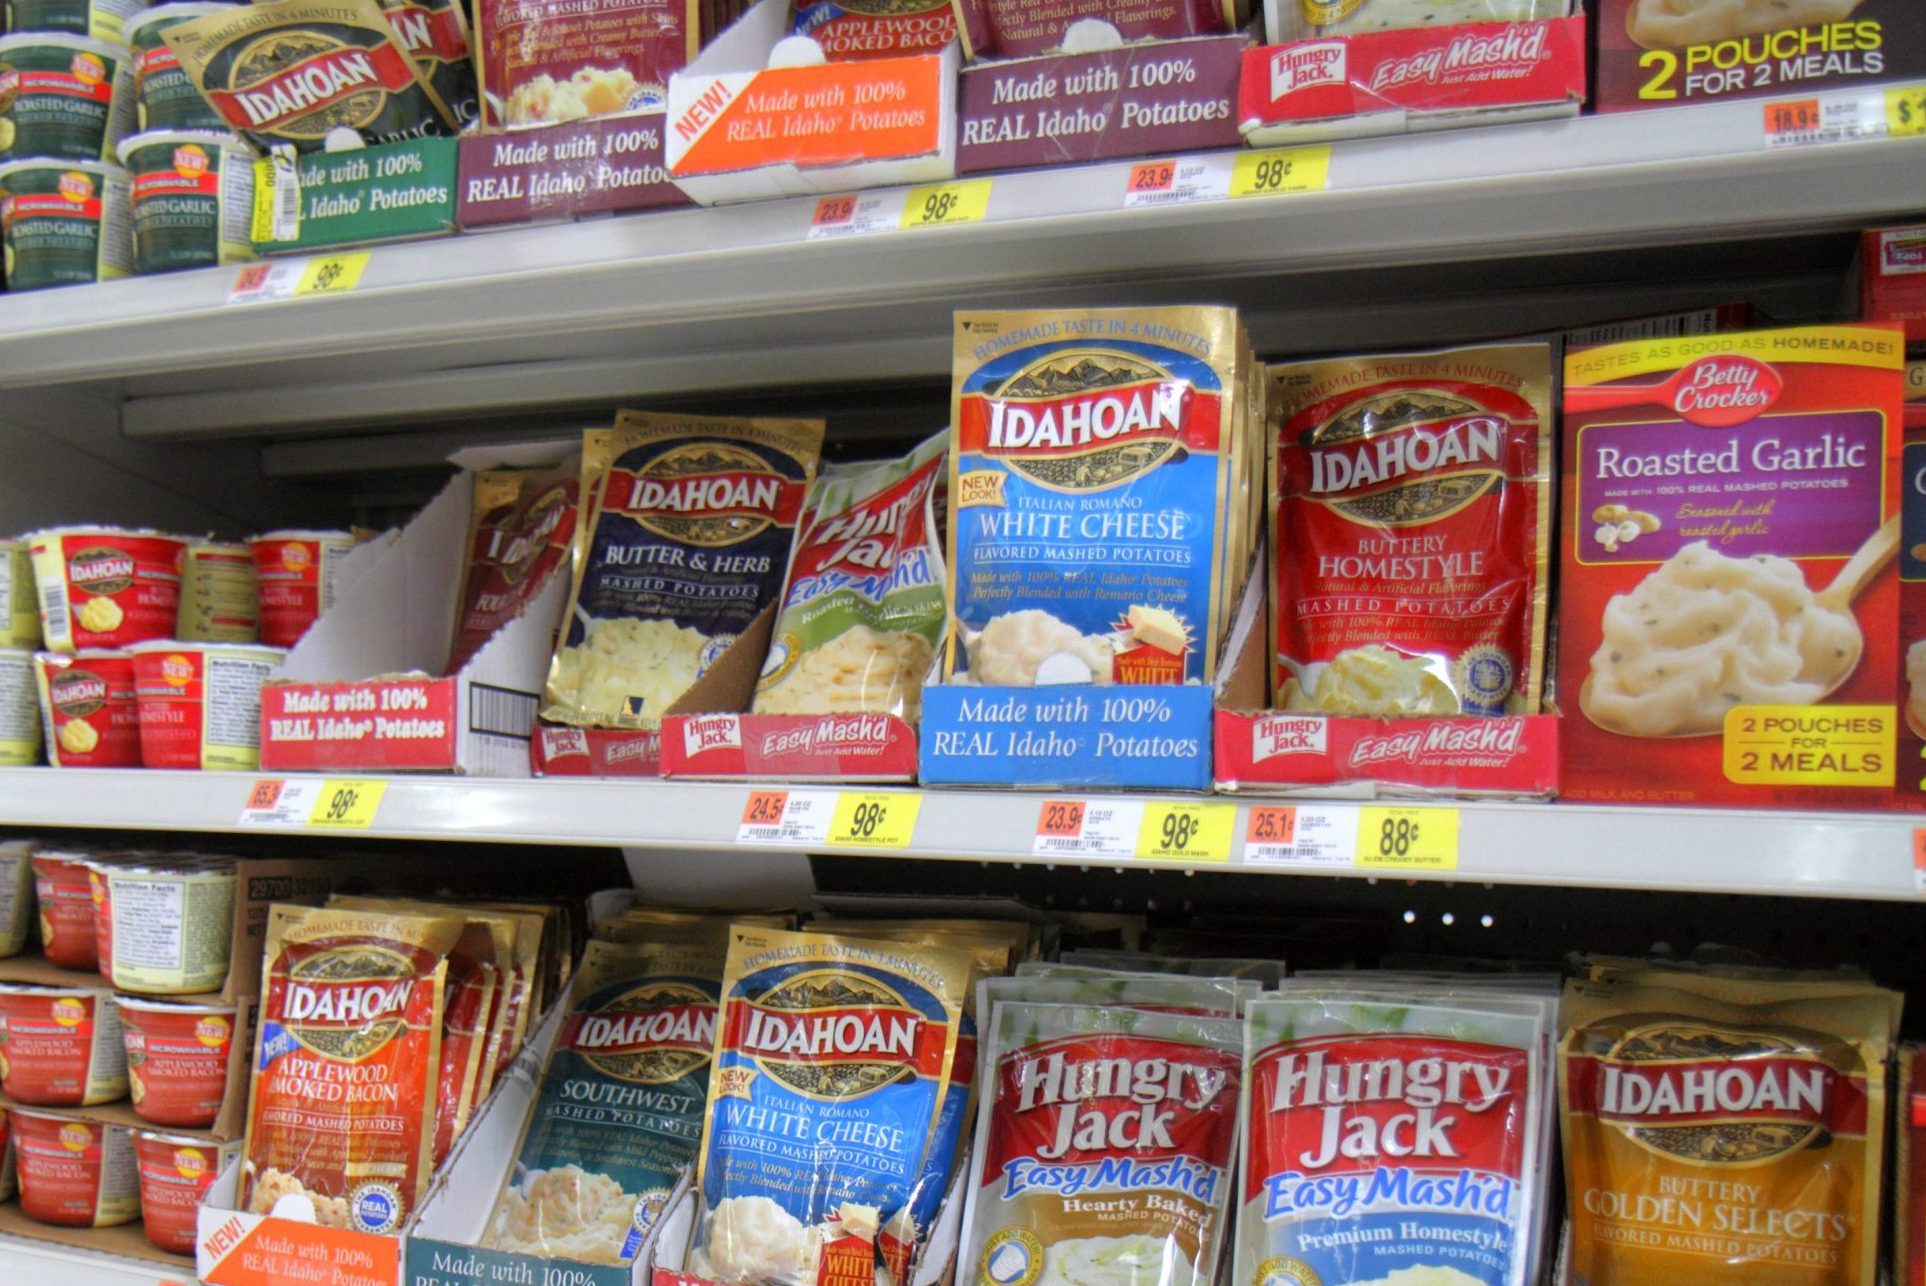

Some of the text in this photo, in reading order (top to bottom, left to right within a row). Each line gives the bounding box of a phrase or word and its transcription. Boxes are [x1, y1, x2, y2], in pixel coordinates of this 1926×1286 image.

[1278, 47, 1341, 75] Hungry
[1373, 24, 1546, 89] Easy Mash'd
[1639, 21, 1882, 100] 2 POUCHES
[235, 53, 378, 126] IDAHOAN
[992, 59, 1195, 104] Made with 100%
[1685, 52, 1884, 97] FOR 2 MEALS
[674, 80, 732, 141] NEW!
[745, 82, 905, 114] Made with 100%
[727, 120, 776, 142] REAL
[849, 108, 925, 132] Potatoes
[962, 115, 1030, 146] REAL
[1120, 99, 1230, 128] Potatoes
[494, 129, 658, 167] Made with 100%
[331, 153, 422, 183] with 100%
[370, 186, 447, 211] Potatoes
[467, 176, 523, 203] REAL
[1062, 319, 1213, 354] TASTE IN MINUTES
[1574, 336, 1894, 376] TASTES AS GOOD AS HOMEMADE!
[1694, 363, 1758, 390] Betty
[1674, 386, 1769, 413] Crocker
[988, 388, 1185, 448] IDAHOAN
[1310, 423, 1500, 493] IDAHOAN
[1596, 433, 1866, 478] Roasted Garlic
[628, 478, 780, 512] IDAHOAN
[962, 476, 998, 490] NEW
[962, 490, 996, 502] LOOK!
[1687, 484, 1720, 493] REAL
[1724, 481, 1777, 492] MASHED
[1781, 478, 1848, 490] POTATOES
[1018, 497, 1142, 510] ITALIAN ROMANO
[980, 511, 1185, 540] WHITE CHEESE
[605, 545, 771, 573] BUTTER & HERB
[974, 547, 1192, 564] FLAVORED MASHED POTATOES
[1358, 534, 1448, 556] BUTTERY
[70, 561, 134, 582] IDAHOAN
[1319, 552, 1484, 580] HOMESTYLE
[1017, 586, 1061, 600] Blended
[1065, 586, 1090, 600] with
[1297, 598, 1510, 615] MASHED POTATOES
[52, 683, 105, 703] IDAHOAN
[283, 688, 427, 714] Made with 100%
[958, 697, 1171, 723] Made with 100%
[270, 717, 445, 741] REAL Potatoes
[689, 714, 736, 737] Hungry
[761, 714, 888, 756] Easy Mash'd
[1260, 717, 1322, 741] Hungry
[1742, 718, 1884, 733] 2 POUCHES
[933, 732, 999, 756] REAL
[1095, 732, 1198, 758] Potatoes
[1352, 718, 1521, 764] Easy Mash'd
[1791, 738, 1826, 748] FOR
[1741, 752, 1883, 773] 2 MEALS
[851, 802, 887, 836] 98¢
[1160, 813, 1199, 850] 98¢
[1380, 817, 1419, 856] 88¢
[284, 980, 414, 1021] IDAHOAN
[744, 1010, 919, 1057] IDAHOAN
[278, 1059, 388, 1083] APPLEWOOD
[720, 1071, 749, 1083] NEW
[1015, 1051, 1225, 1113] Hungry
[1271, 1050, 1510, 1114] Hungry
[347, 1082, 397, 1101] BACON
[560, 1080, 695, 1115] SOUTHWEST
[1601, 1067, 1825, 1115] IDAHOAN
[764, 1095, 869, 1119] ITALIAN ROMANO
[726, 1104, 903, 1153] WHITE CHEESE
[1037, 1104, 1176, 1159] Jack
[1300, 1106, 1459, 1169] Jack
[1002, 1156, 1218, 1203] Easy Mash'd
[1264, 1168, 1510, 1219] Easy Mash'd
[1660, 1175, 1762, 1204] BUTTERY
[1063, 1195, 1212, 1228] Hearty Baked
[1098, 1211, 1148, 1222] MASHED
[1584, 1188, 1846, 1242] GOLDEN SELECTS
[204, 1217, 246, 1260] NEW!
[256, 1236, 373, 1269] Made with 100%
[1297, 1225, 1392, 1251] Premium
[1374, 1244, 1433, 1256] MASHED
[1667, 1234, 1740, 1257] MASHED
[243, 1255, 282, 1274] REAL
[432, 1252, 485, 1277] Made
[491, 1259, 532, 1285] with
